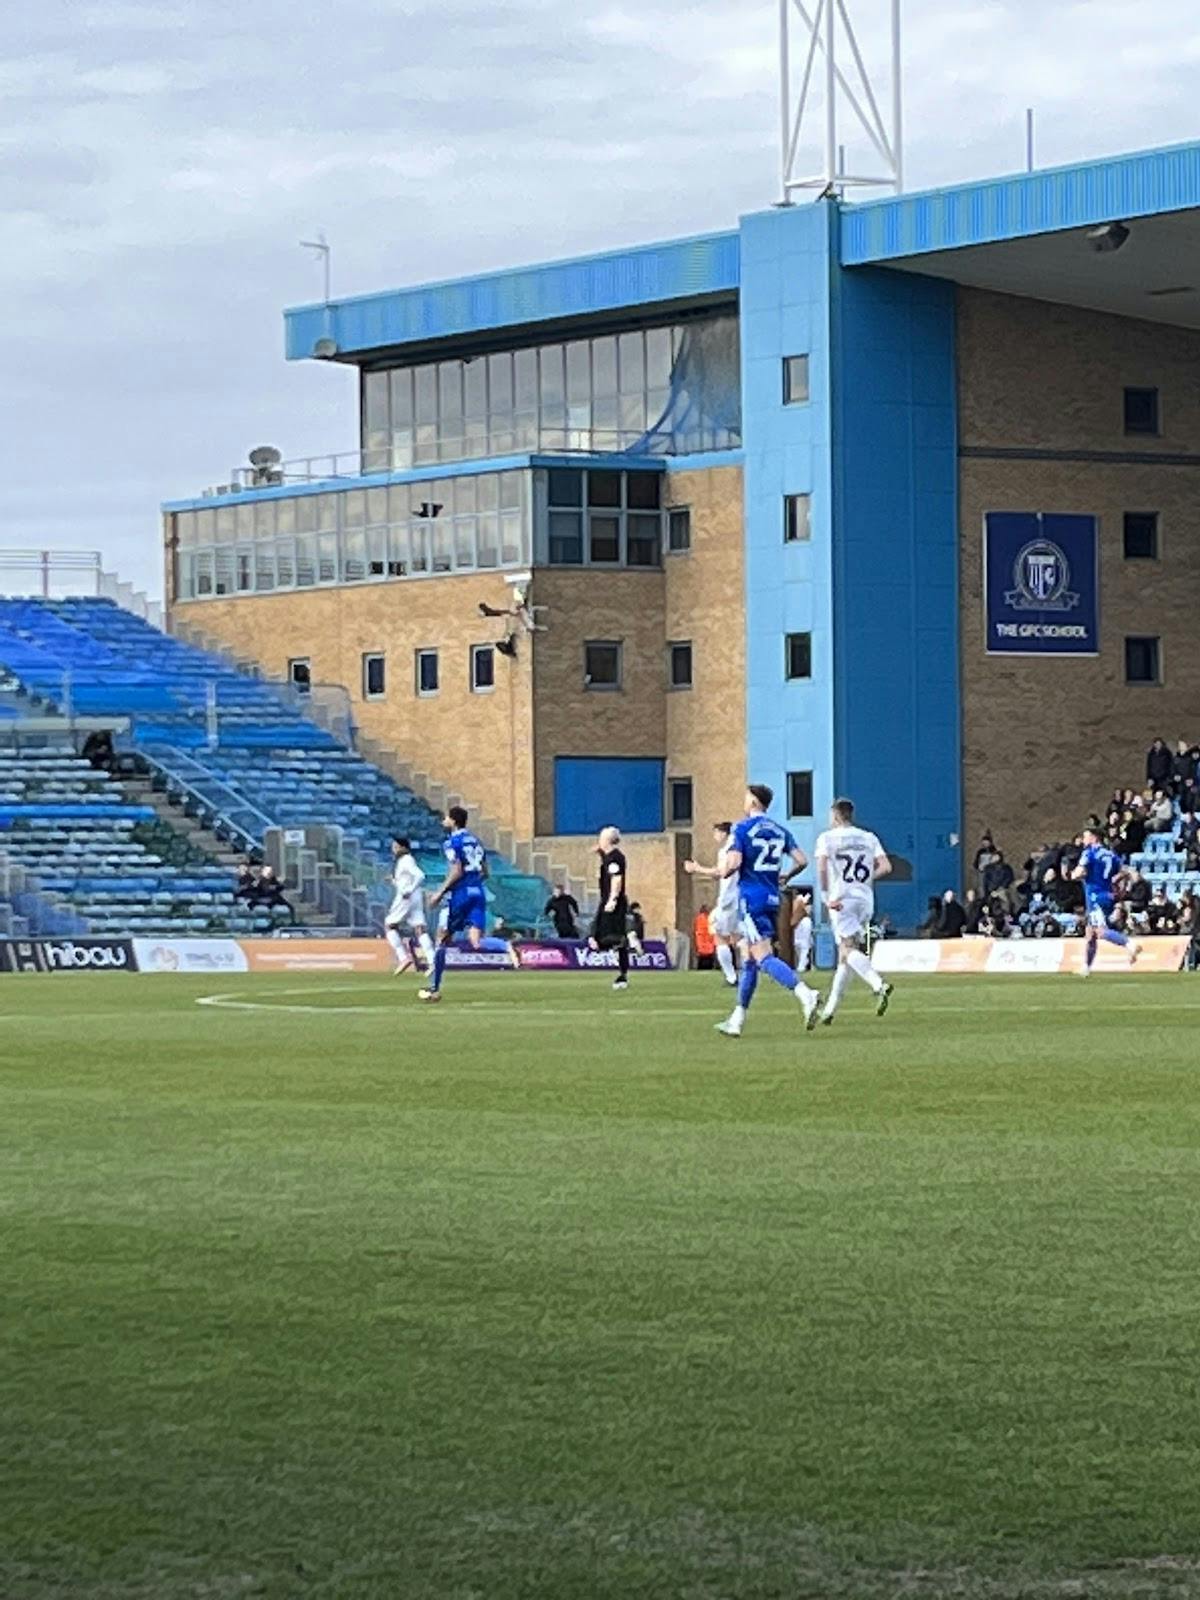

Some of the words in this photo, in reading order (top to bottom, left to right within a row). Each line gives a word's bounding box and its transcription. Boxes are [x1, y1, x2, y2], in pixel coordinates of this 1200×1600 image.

[996, 623, 1017, 637] THE
[1043, 625, 1088, 638] SCHOOL
[751, 838, 785, 872] 23
[1101, 856, 1112, 879] 7
[835, 854, 870, 883] 26
